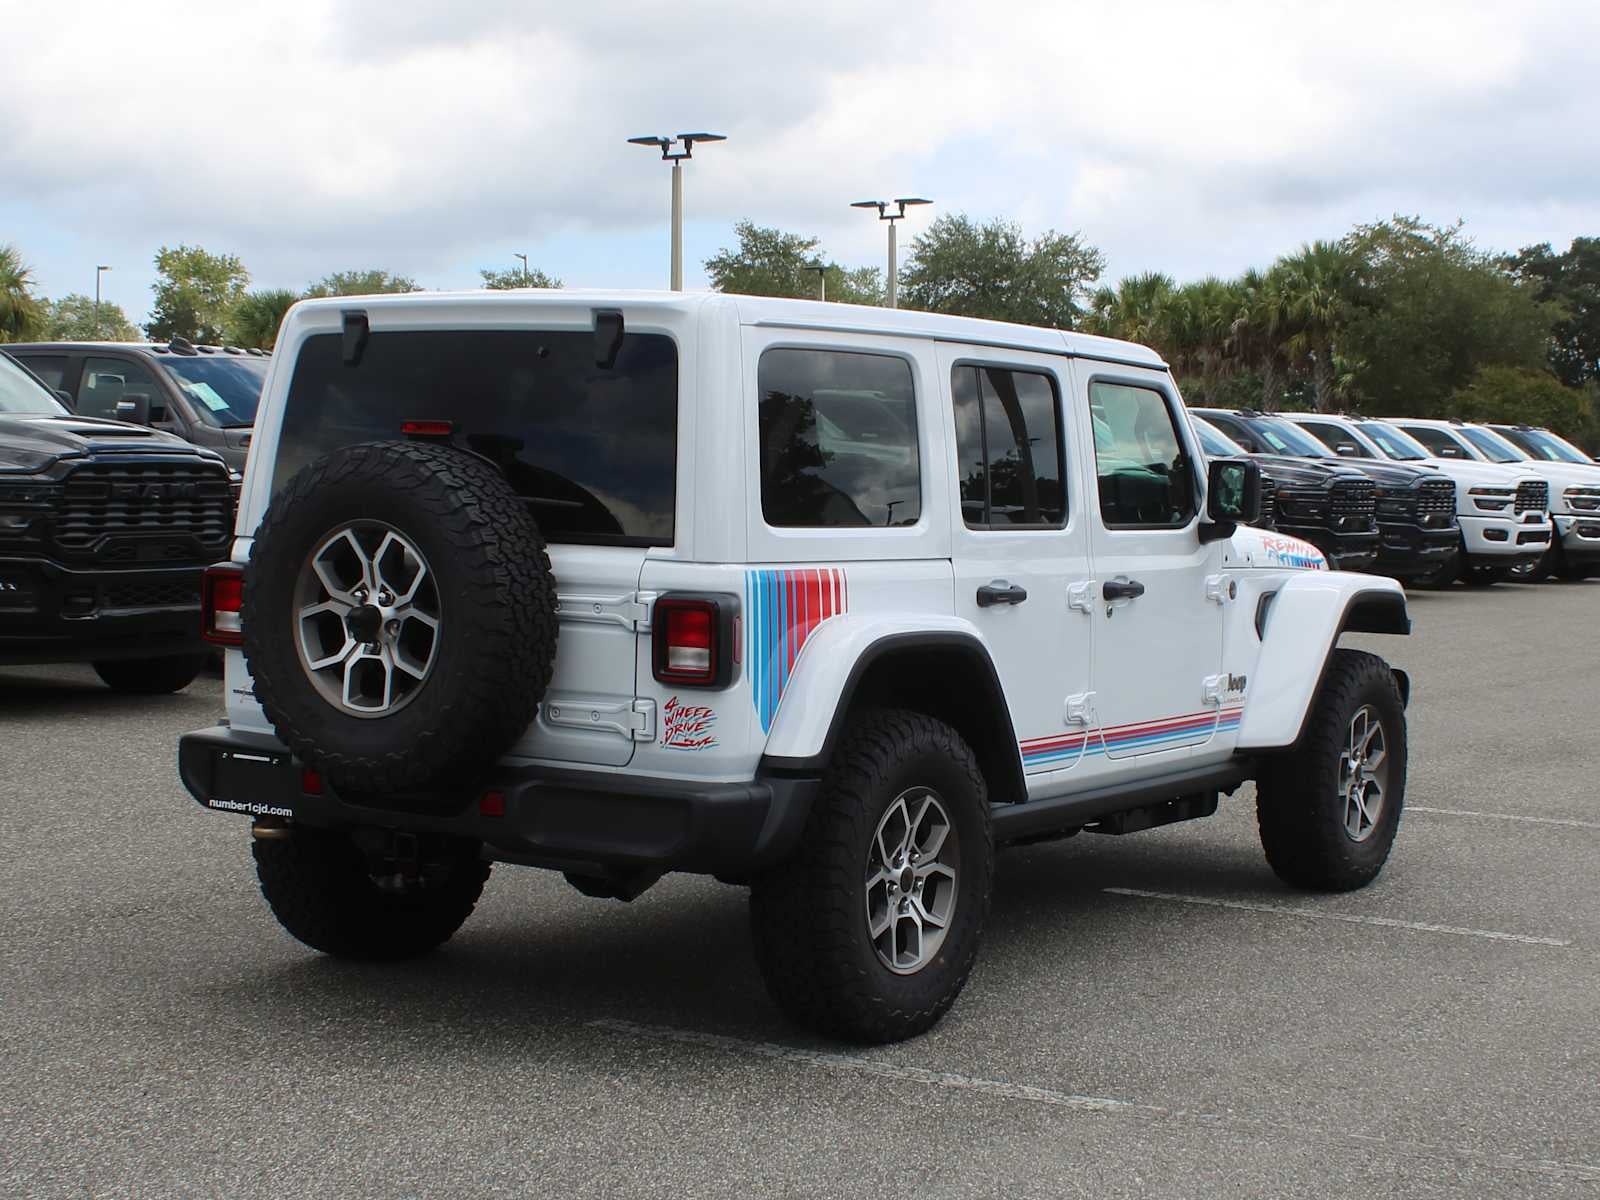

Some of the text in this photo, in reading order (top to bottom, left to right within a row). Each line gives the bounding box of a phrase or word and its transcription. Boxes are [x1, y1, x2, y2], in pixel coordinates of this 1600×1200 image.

[664, 696, 679, 712] 4
[664, 721, 707, 744] DRIVE
[209, 799, 292, 816] number1cjd.com
